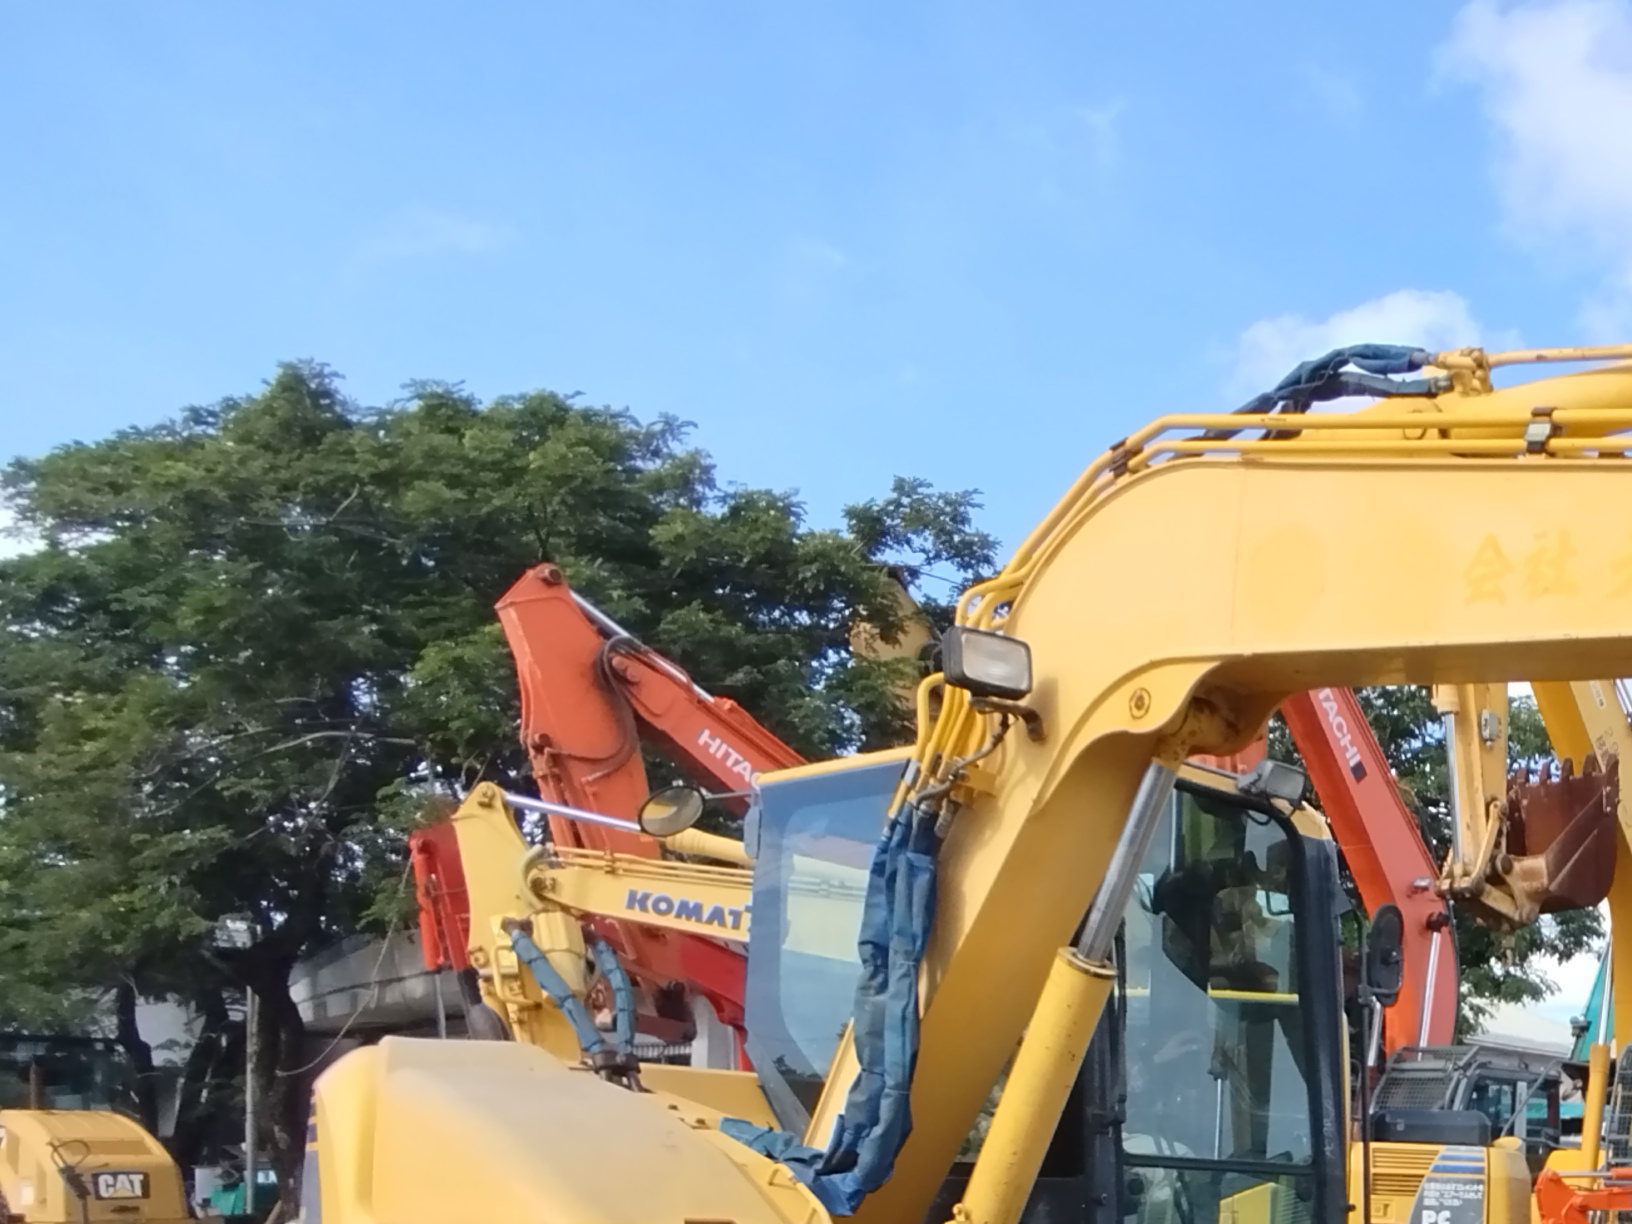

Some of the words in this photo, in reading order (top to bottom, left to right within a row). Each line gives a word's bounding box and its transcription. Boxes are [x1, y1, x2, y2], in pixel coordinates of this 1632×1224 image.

[1318, 688, 1361, 767] TACHI
[698, 728, 761, 790] HITAC
[625, 889, 752, 931] KOMAT
[99, 1173, 144, 1199] CAT
